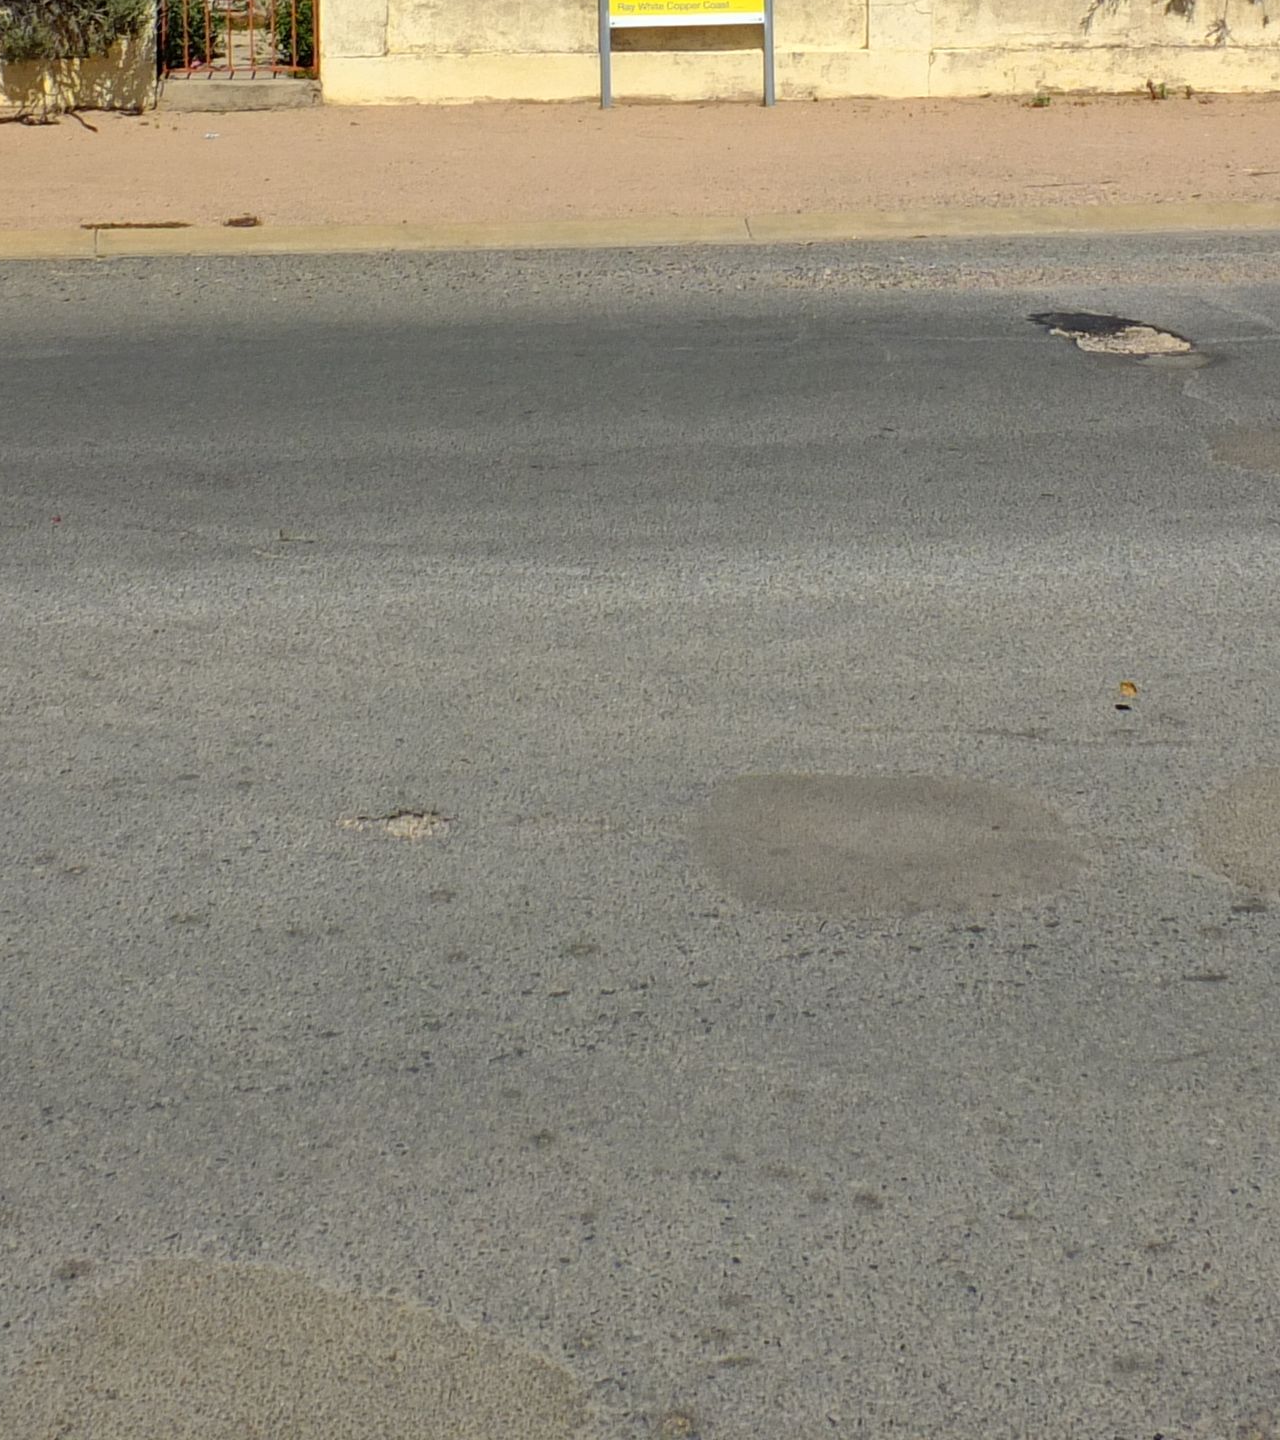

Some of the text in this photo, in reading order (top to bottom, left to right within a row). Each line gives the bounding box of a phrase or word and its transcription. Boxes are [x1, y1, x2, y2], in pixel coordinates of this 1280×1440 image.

[617, 2, 636, 12] Ray
[638, 1, 665, 11] White
[666, 1, 701, 11] Copper
